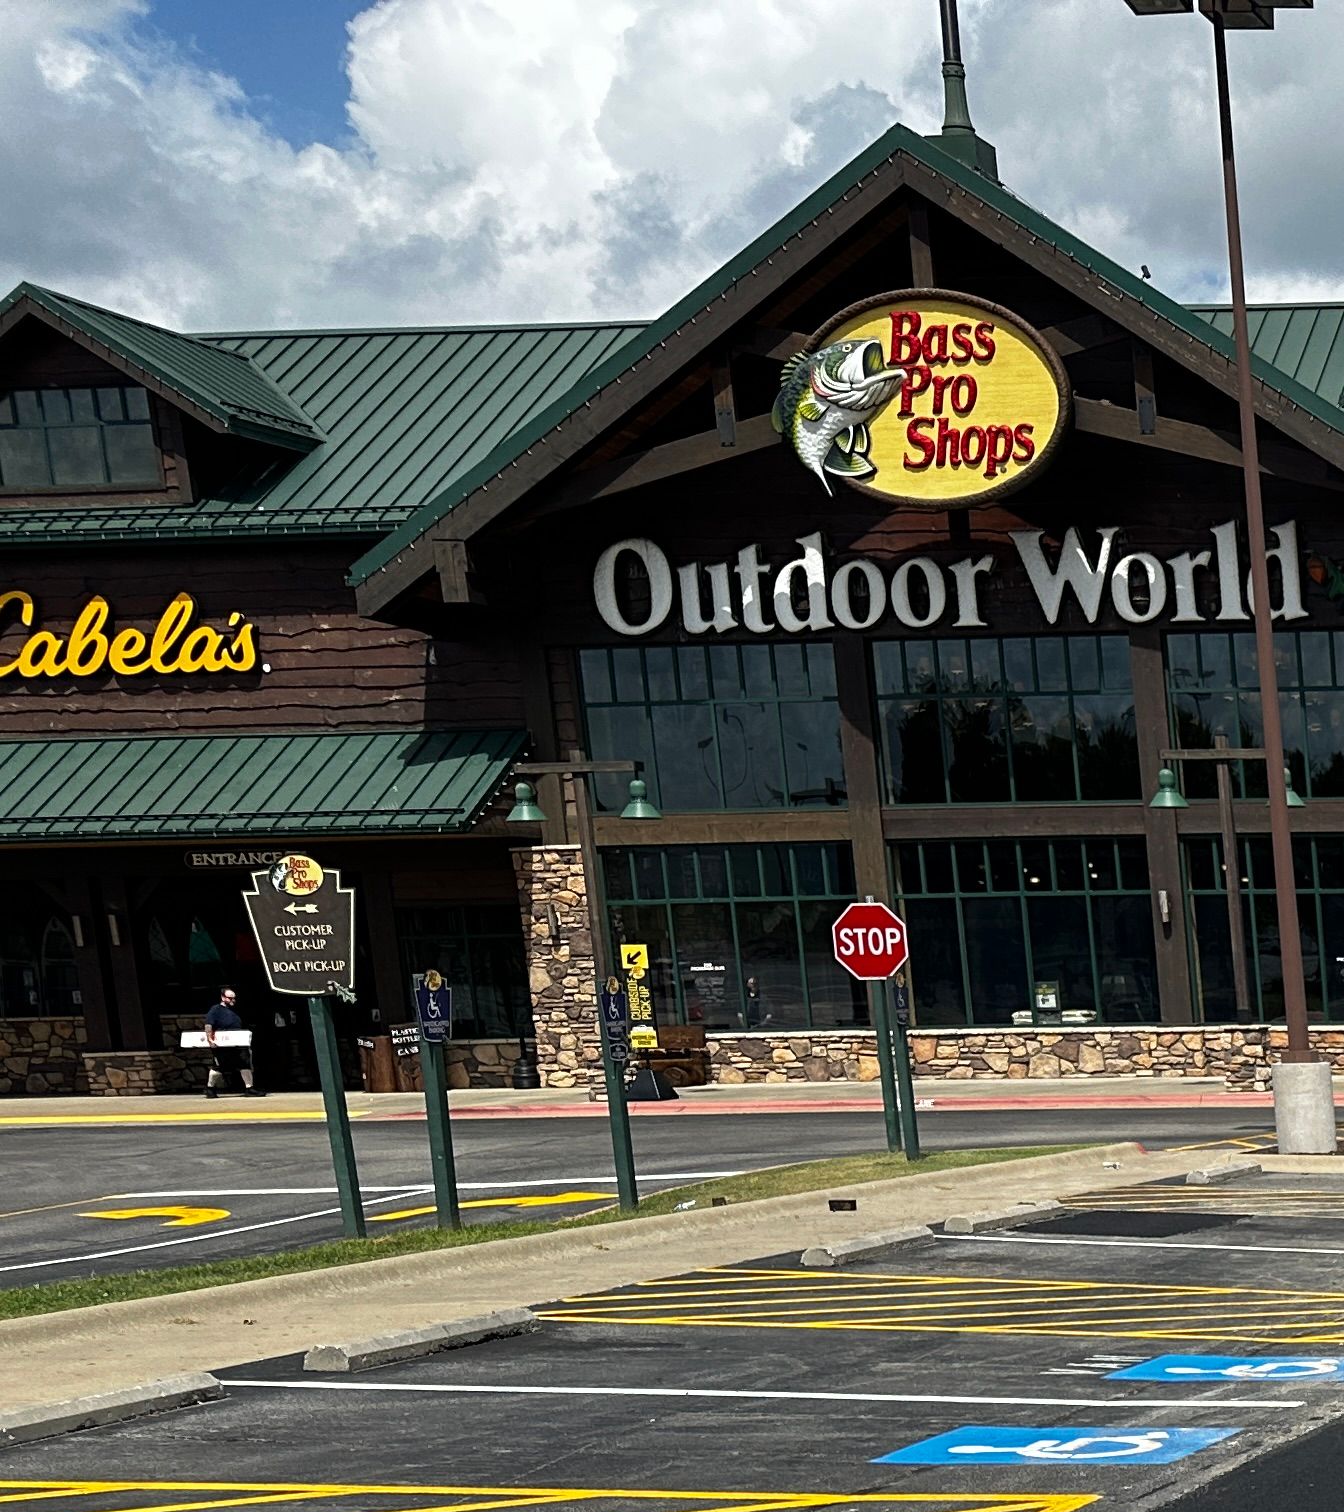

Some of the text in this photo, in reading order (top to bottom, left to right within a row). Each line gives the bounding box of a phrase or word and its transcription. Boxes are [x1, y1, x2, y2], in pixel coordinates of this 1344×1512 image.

[887, 311, 996, 366] Bass
[897, 365, 977, 418] Pro
[903, 417, 1035, 477] Shops
[593, 518, 1310, 636] Outdoor World
[0, 591, 256, 677] Cabela's
[289, 856, 310, 869] Bass
[291, 868, 307, 879] Pro
[293, 878, 319, 891] Shops
[274, 925, 334, 936] CUSTOMER
[285, 939, 327, 951] PICK-UP
[839, 927, 901, 956] STOP
[273, 960, 346, 973] BOAT PICK-UP
[626, 977, 642, 1020] CURBSIDE
[638, 985, 652, 1020] PICK-UP
[397, 1045, 420, 1056] CANS
